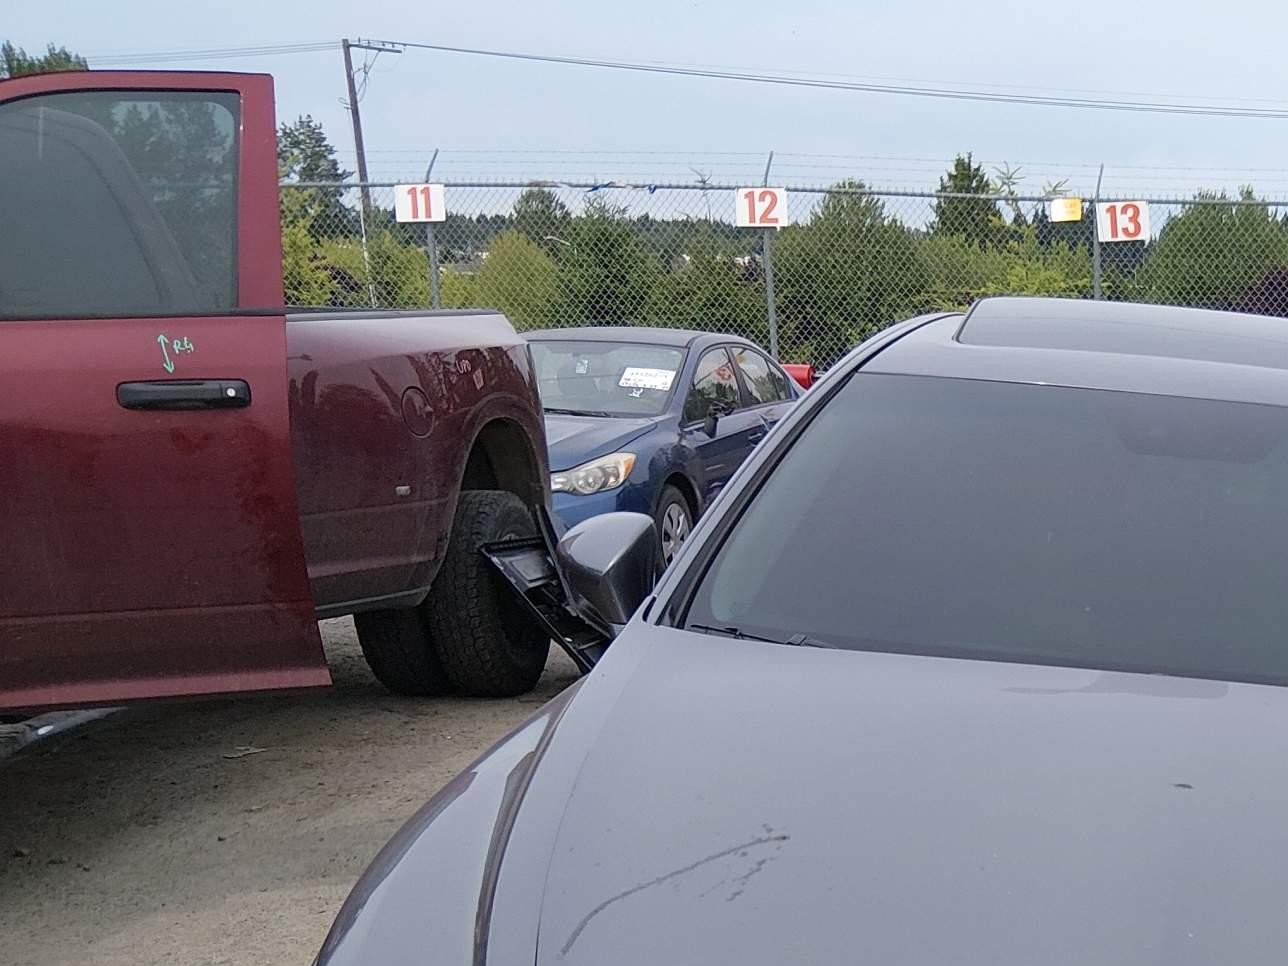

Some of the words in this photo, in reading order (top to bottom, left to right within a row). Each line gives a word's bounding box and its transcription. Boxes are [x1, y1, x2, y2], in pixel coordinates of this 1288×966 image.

[407, 187, 432, 219] 11
[743, 190, 779, 224] 12
[1105, 203, 1142, 239] 13
